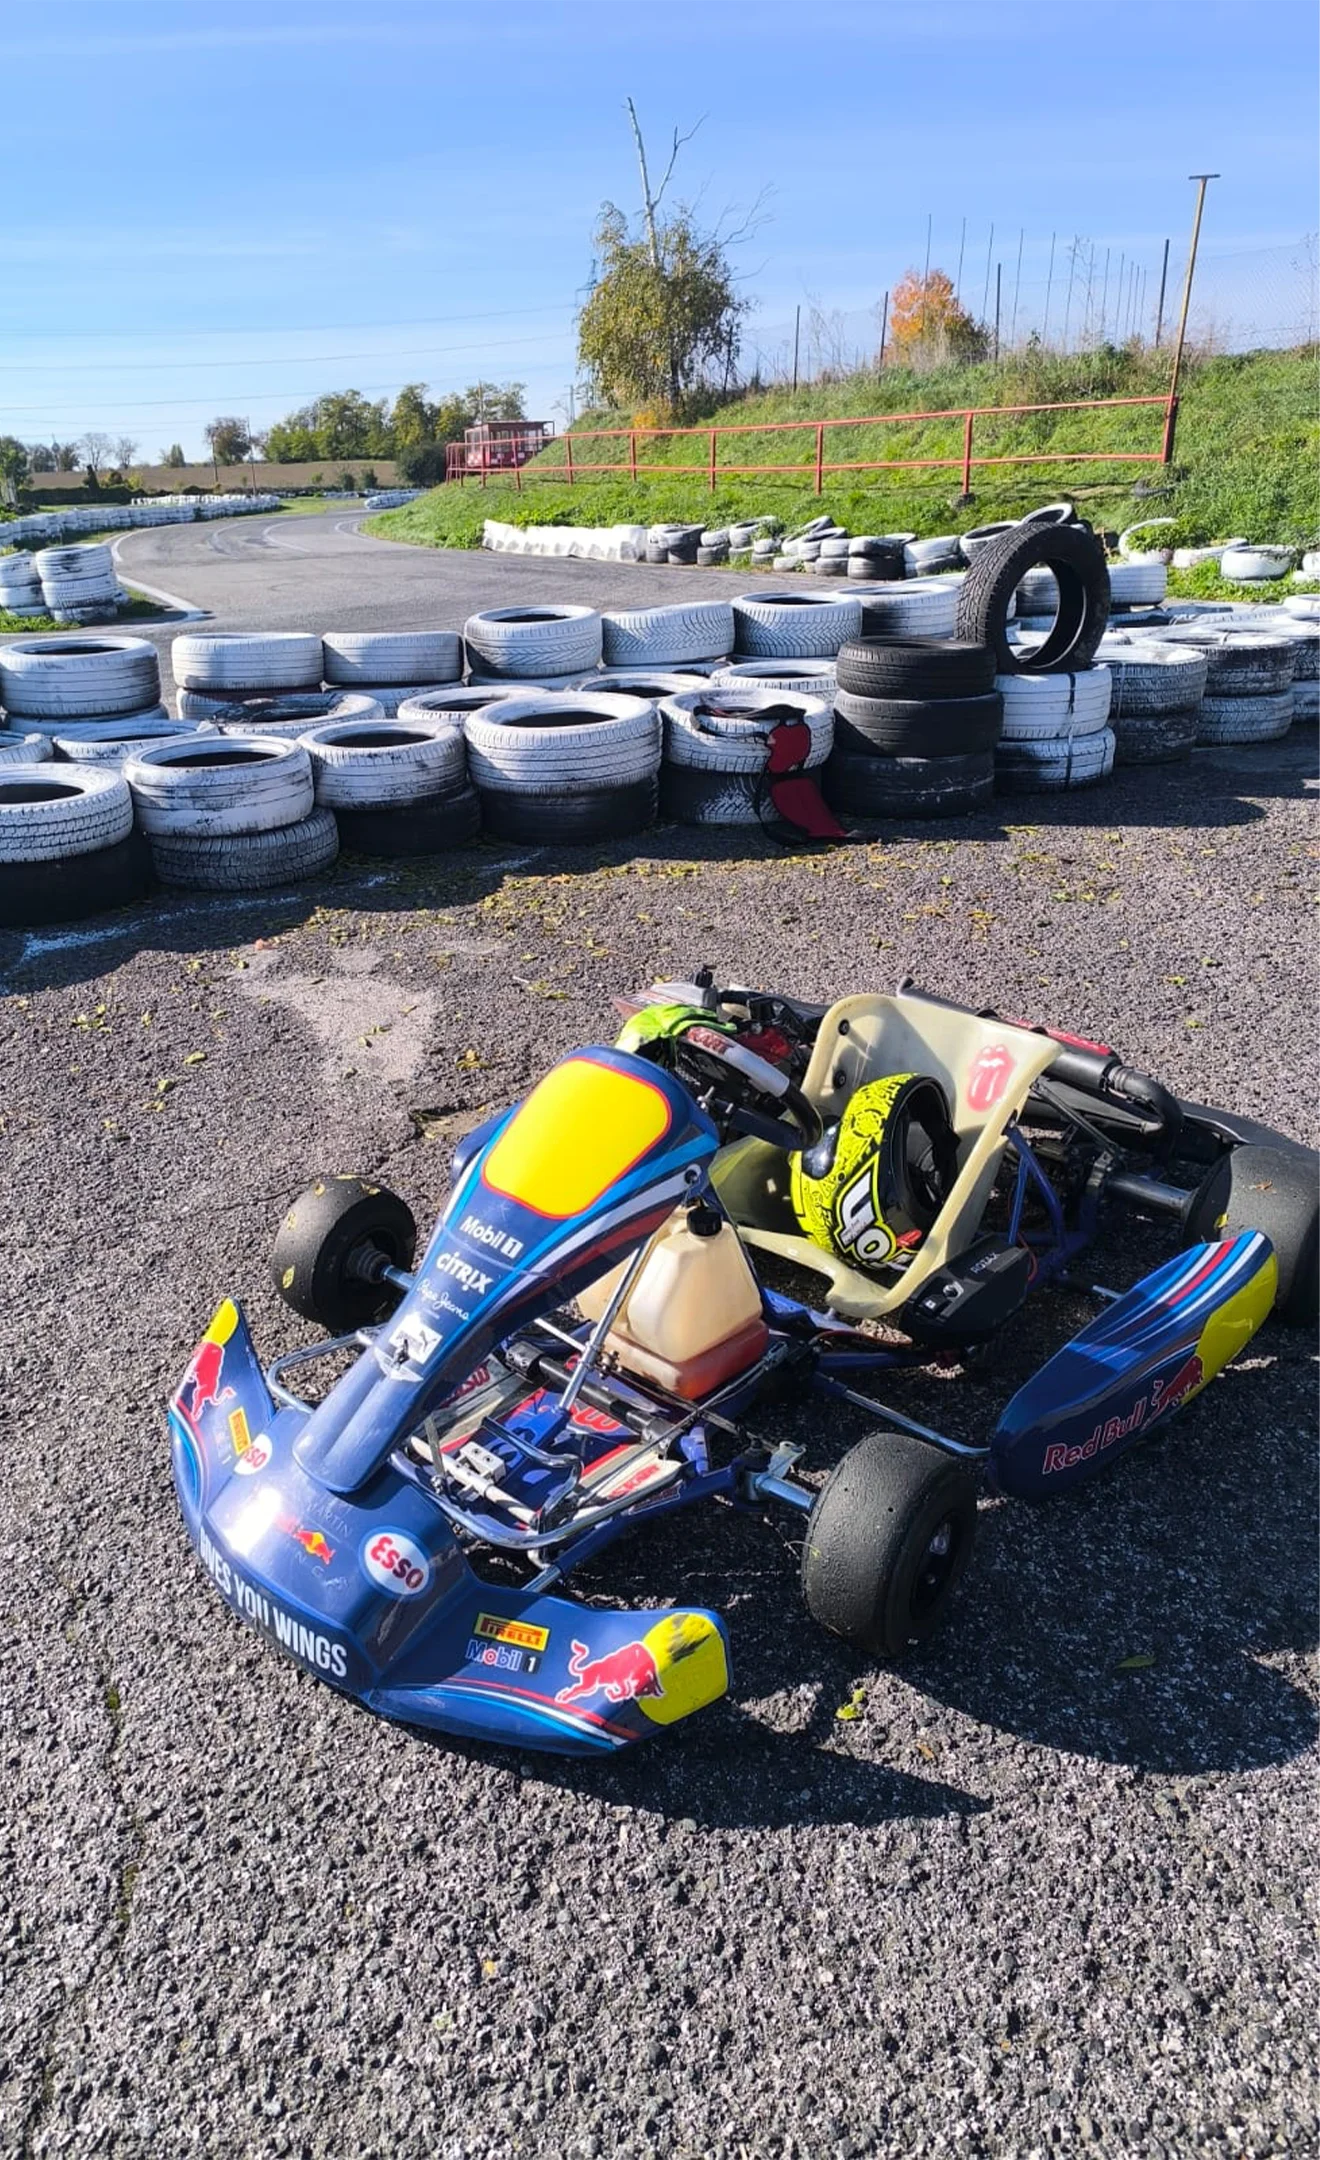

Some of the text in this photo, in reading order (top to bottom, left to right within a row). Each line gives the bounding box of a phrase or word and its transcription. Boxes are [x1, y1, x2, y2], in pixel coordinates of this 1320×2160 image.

[459, 1215, 506, 1250] Mobil
[1042, 1396, 1148, 1475] Red Bull
[233, 1572, 269, 1627] YOU
[272, 1606, 348, 1678] WINGS
[479, 1616, 543, 1647] PIRELLI
[464, 1638, 537, 1673] Mobil 1
